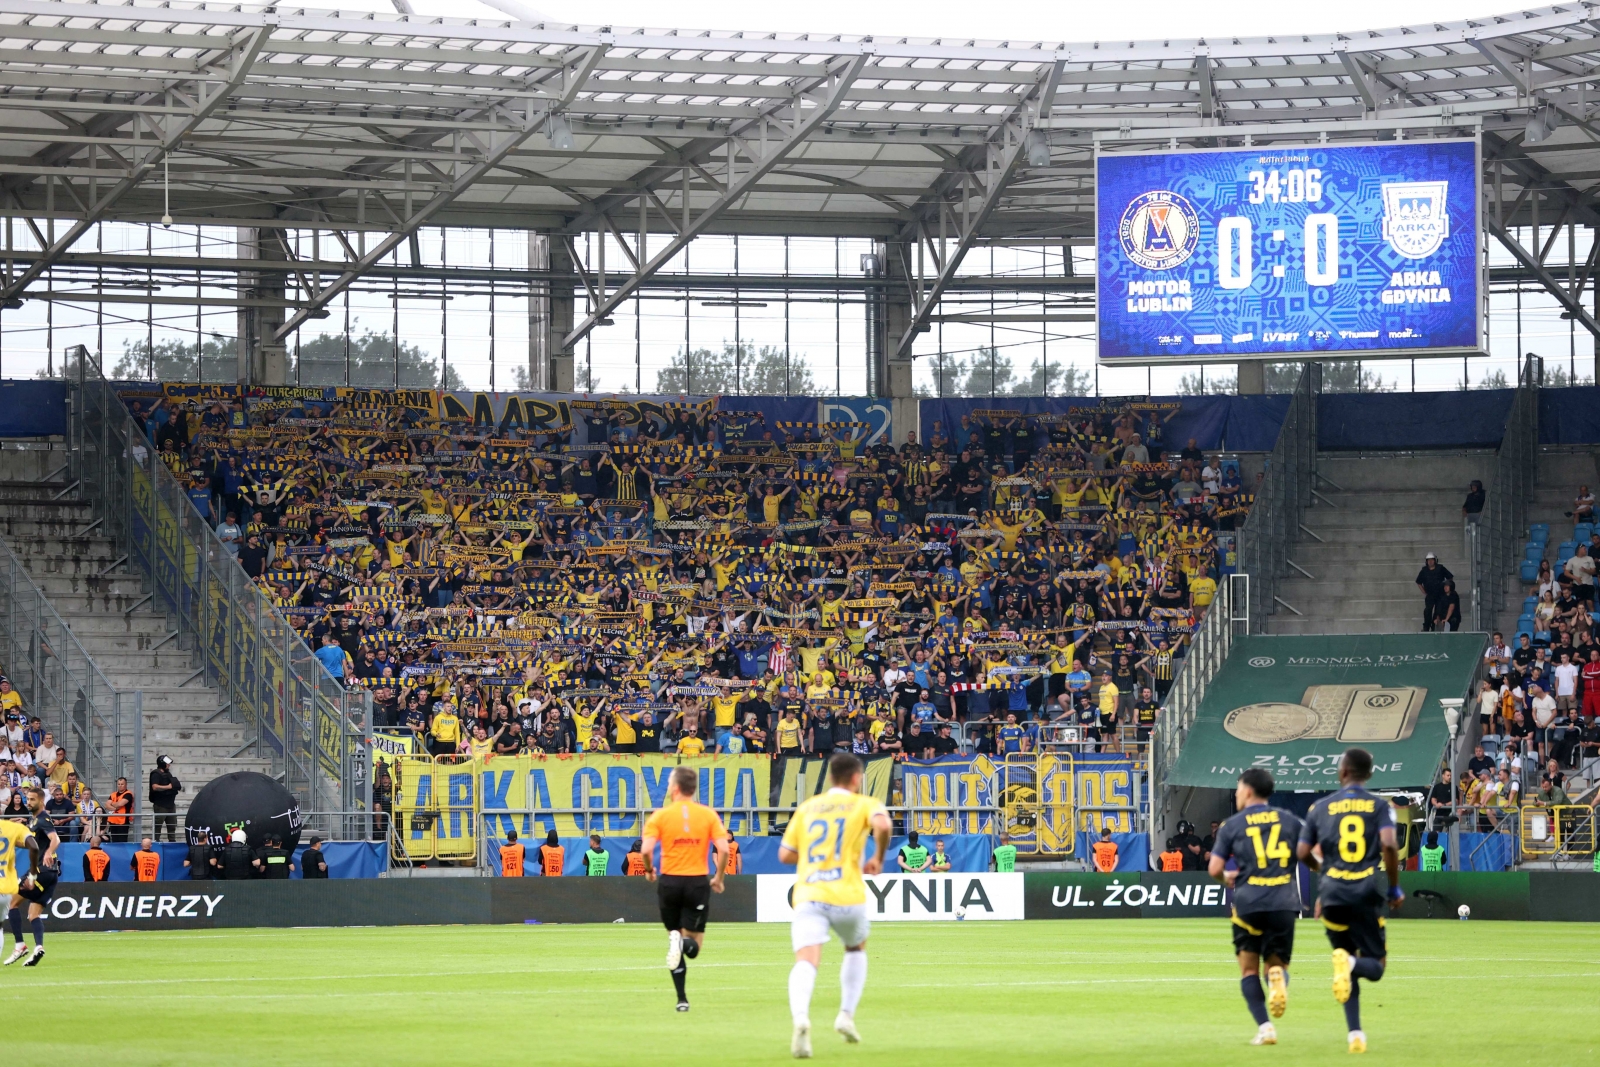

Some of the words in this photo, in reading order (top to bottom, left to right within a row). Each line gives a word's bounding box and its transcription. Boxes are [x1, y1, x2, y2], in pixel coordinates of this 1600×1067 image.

[1249, 168, 1322, 205] 34:06
[1396, 223, 1436, 232] ARKA
[1218, 216, 1253, 290] 0
[1304, 213, 1339, 287] 0
[1128, 280, 1192, 296] MOTOR
[1390, 270, 1442, 287] ARKA
[1127, 296, 1193, 313] LUBLIN
[1381, 287, 1452, 305] GDYNIA
[329, 526, 363, 534] JANOWO
[1287, 656, 1372, 665] MENNICA
[1378, 652, 1450, 663] POLSKA
[411, 769, 554, 840] ARKA
[1327, 799, 1376, 816] SIDIBE
[1245, 811, 1280, 825] HIDE
[808, 818, 846, 864] 21
[1245, 823, 1292, 869] 14
[1338, 815, 1367, 863] 8
[788, 878, 994, 914] YNIA
[1051, 885, 1096, 908] UL.
[28, 894, 225, 919] OŁNIERZY
